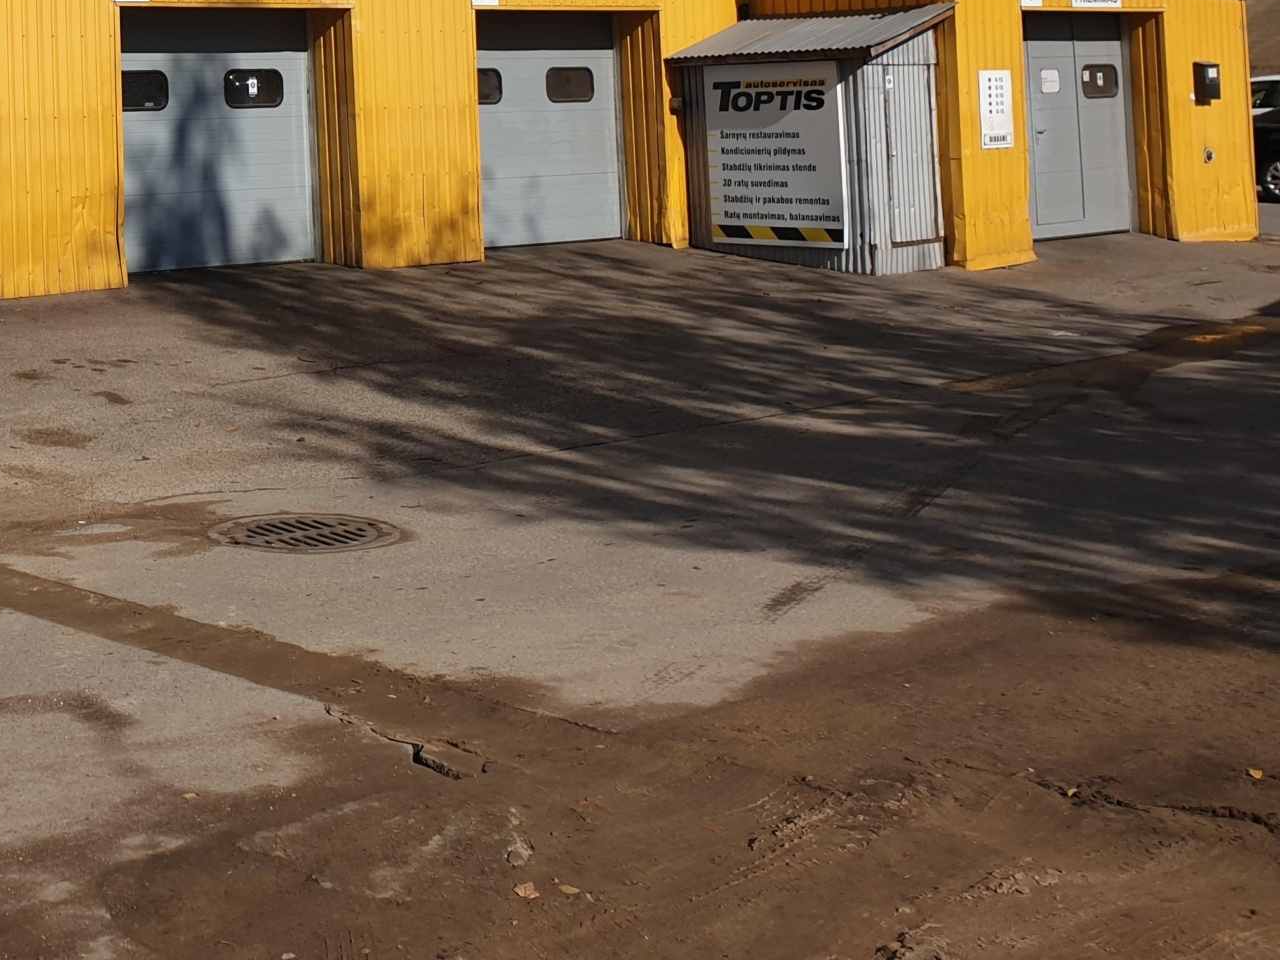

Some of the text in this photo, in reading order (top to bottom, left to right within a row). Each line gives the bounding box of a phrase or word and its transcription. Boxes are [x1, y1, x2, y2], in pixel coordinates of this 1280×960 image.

[745, 79, 826, 89] autoservisas
[712, 81, 826, 112] TOPTIS
[720, 129, 800, 141] Šarnyrų restauravimas
[721, 146, 806, 157] Kondicionierių pildymas
[722, 162, 817, 173] Stabdžių tikrinimas stende
[723, 179, 789, 189] 3D ratų suvedimas
[723, 195, 830, 206] Stabdžių ir pakabos remontas
[724, 210, 841, 223] Ratų montavimas, balansavimas
